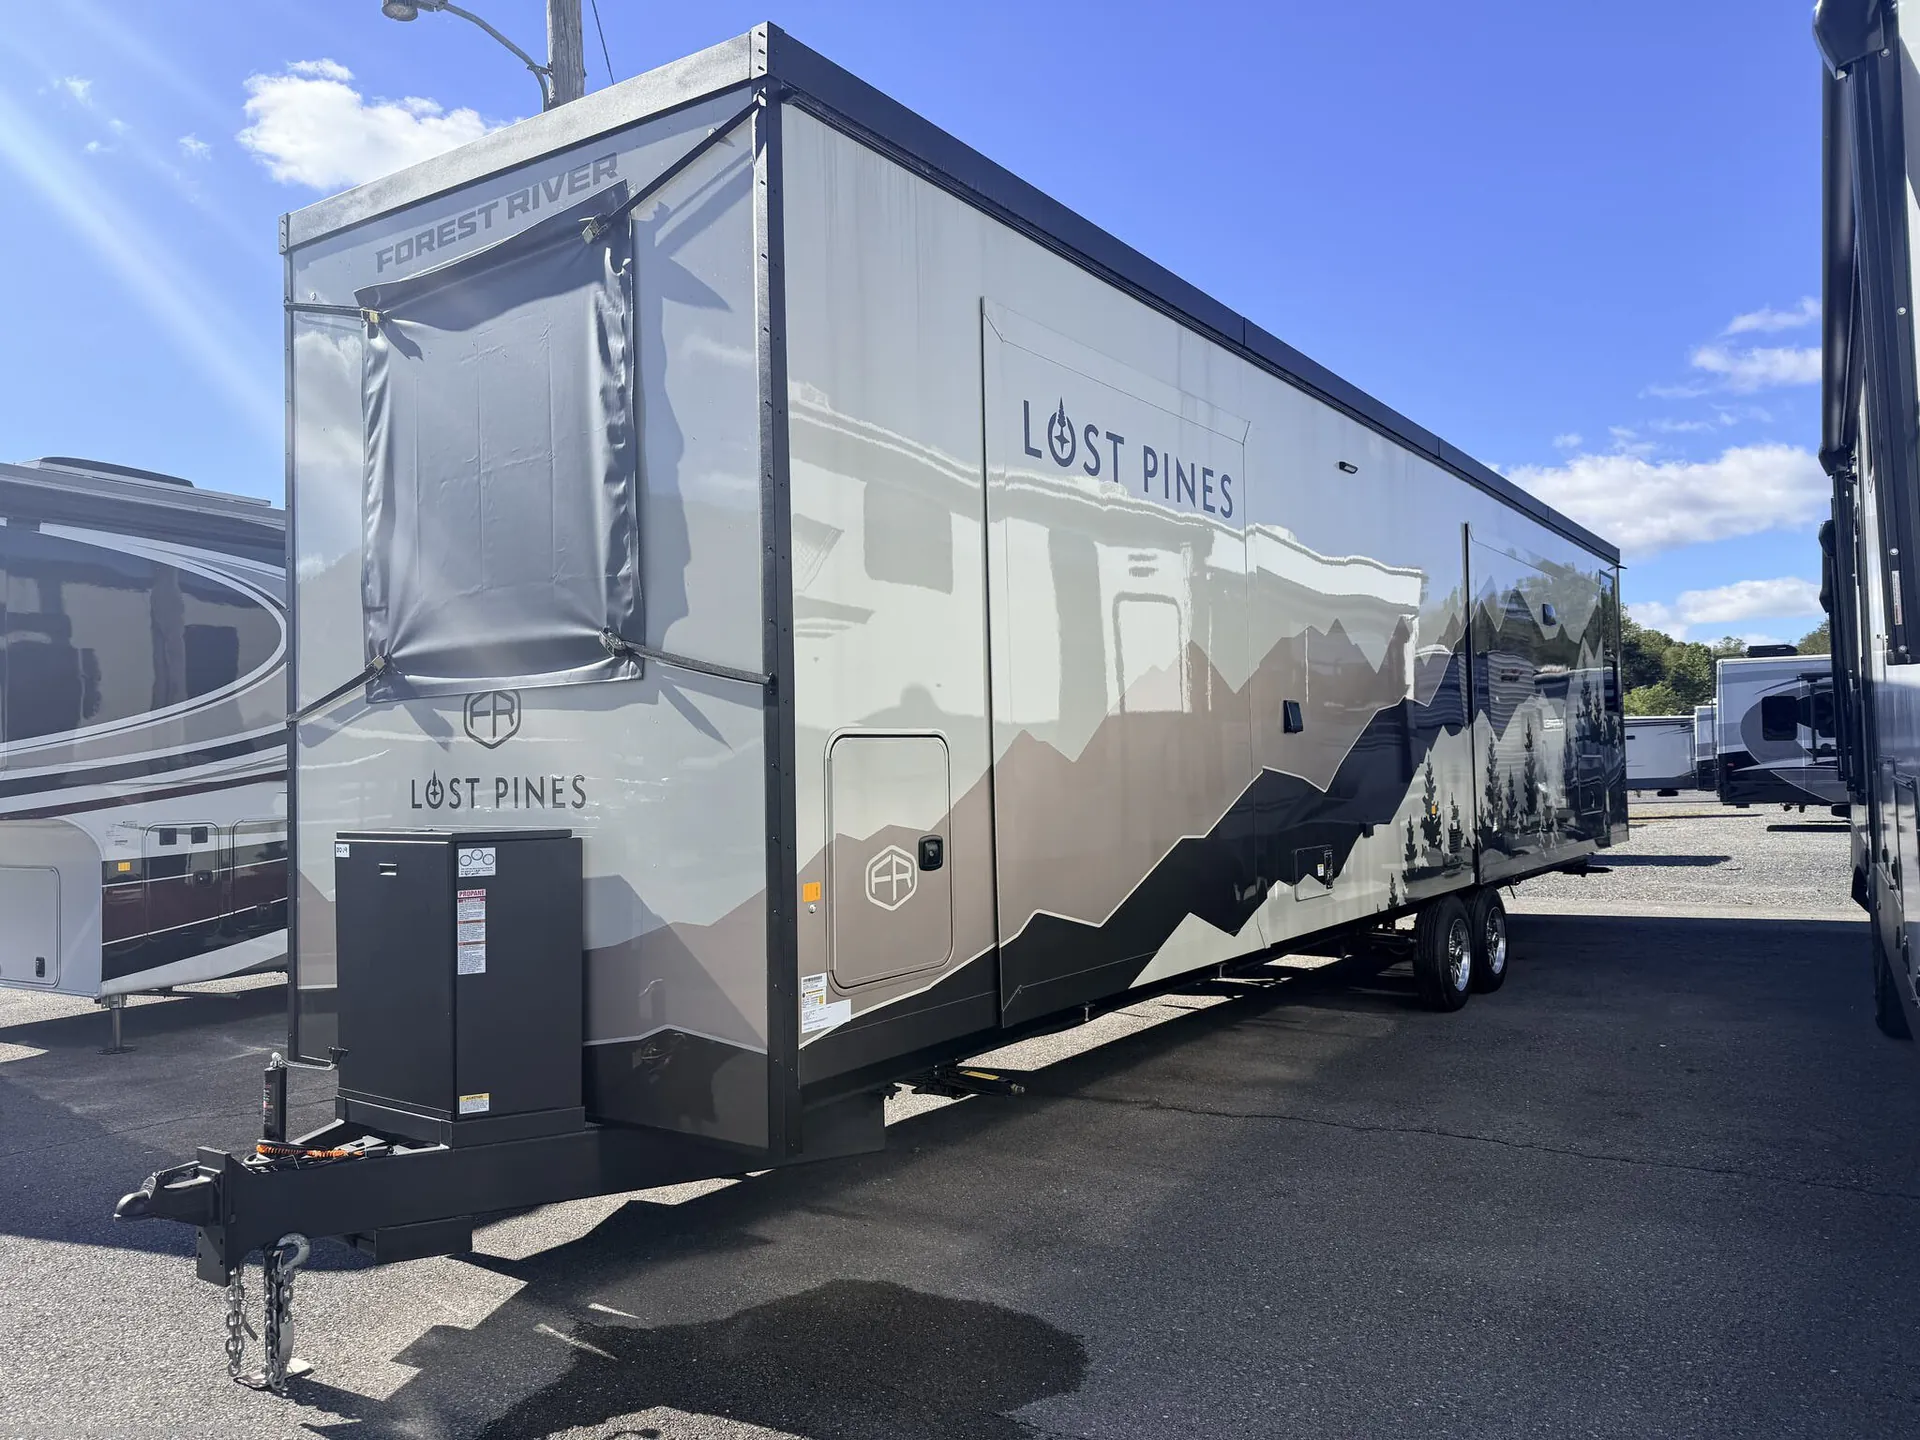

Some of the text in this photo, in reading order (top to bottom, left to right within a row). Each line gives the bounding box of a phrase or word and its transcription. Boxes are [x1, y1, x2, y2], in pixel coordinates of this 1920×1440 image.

[375, 152, 618, 273] FOREST RIVER
[1023, 397, 1233, 519] LOST PINES
[411, 769, 587, 810] LOST PINES
[459, 889, 485, 897] PROPANE
